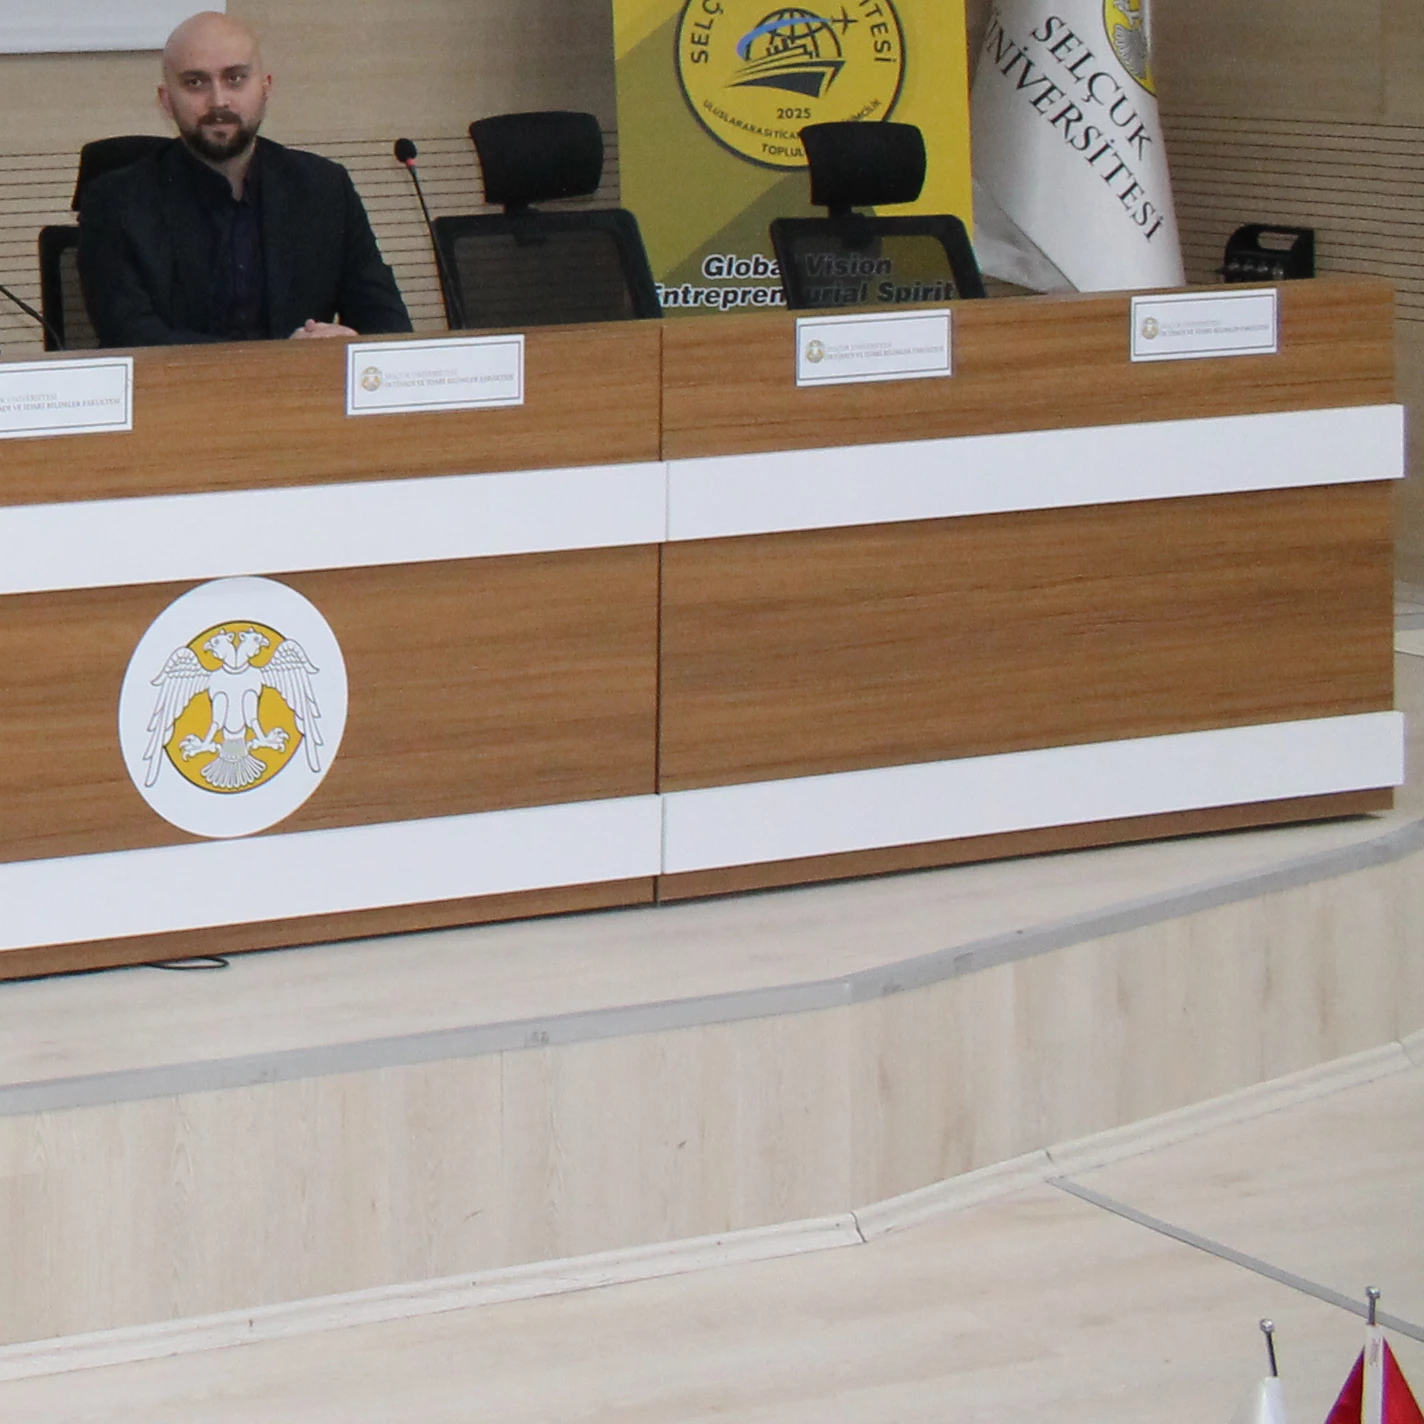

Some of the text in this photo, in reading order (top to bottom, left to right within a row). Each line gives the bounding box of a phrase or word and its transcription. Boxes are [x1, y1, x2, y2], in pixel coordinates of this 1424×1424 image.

[1030, 16, 1154, 161] SELÇUK
[777, 108, 812, 119] 2025
[761, 143, 805, 157] TOPLUL
[703, 254, 893, 278] Globa Vision
